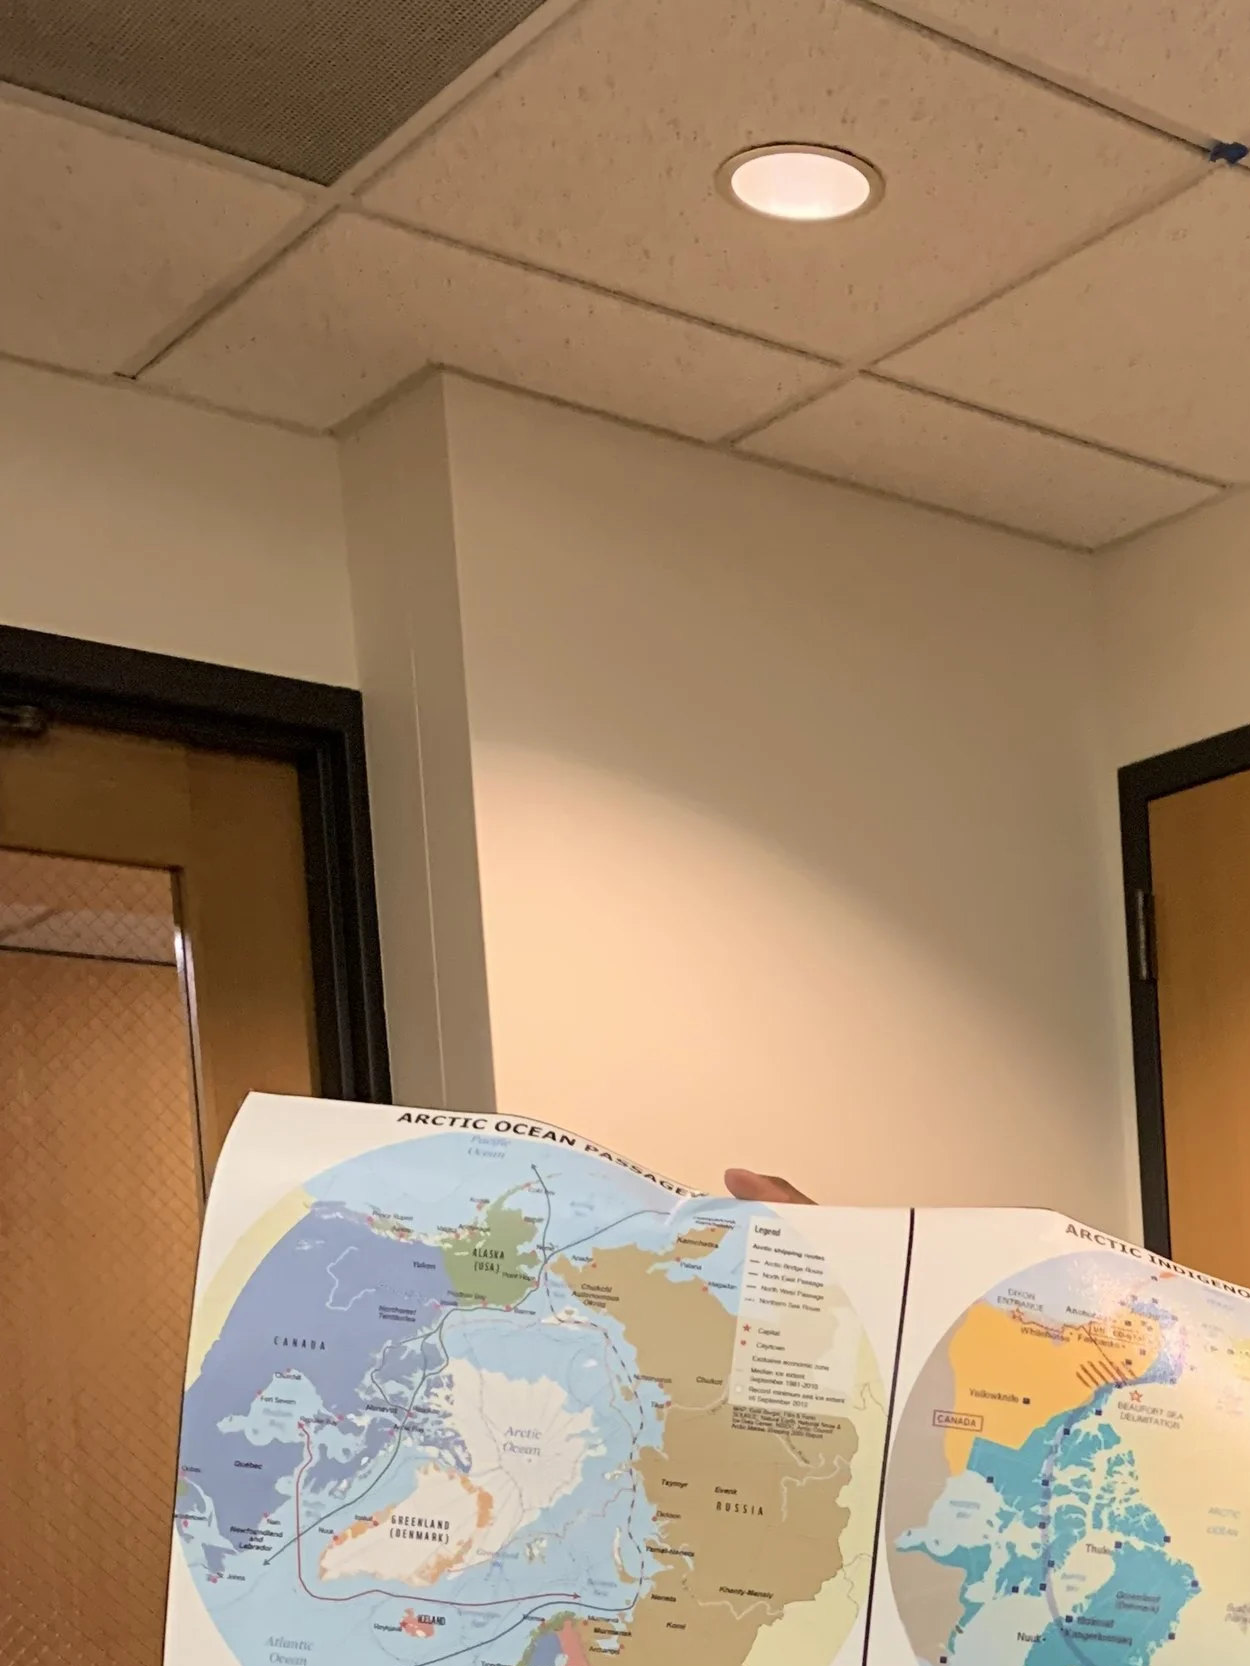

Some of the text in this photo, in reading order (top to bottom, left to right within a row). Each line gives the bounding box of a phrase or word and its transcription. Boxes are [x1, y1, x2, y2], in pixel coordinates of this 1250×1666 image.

[397, 1112, 487, 1130] ARCTIC
[494, 1120, 576, 1147] OCEAN
[754, 1225, 781, 1237] Legend
[1065, 1223, 1142, 1259] ARCTIC
[472, 1248, 505, 1259] ALASKA
[473, 1261, 500, 1274] (USA)
[763, 1271, 779, 1281] North
[761, 1284, 778, 1294] North
[274, 1336, 326, 1351] CANADA
[937, 1414, 977, 1428] CANADA
[504, 1426, 542, 1441] Arctic
[503, 1441, 541, 1456] Ocean
[716, 1501, 764, 1517] RUSSIA
[391, 1515, 450, 1530] GREENLAND
[390, 1529, 450, 1545] (DENMARK)
[417, 1614, 446, 1626] ICELAND
[264, 1636, 314, 1651] Atlantic
[1017, 1633, 1042, 1643] Nuuk
[269, 1652, 307, 1666] Ocean
